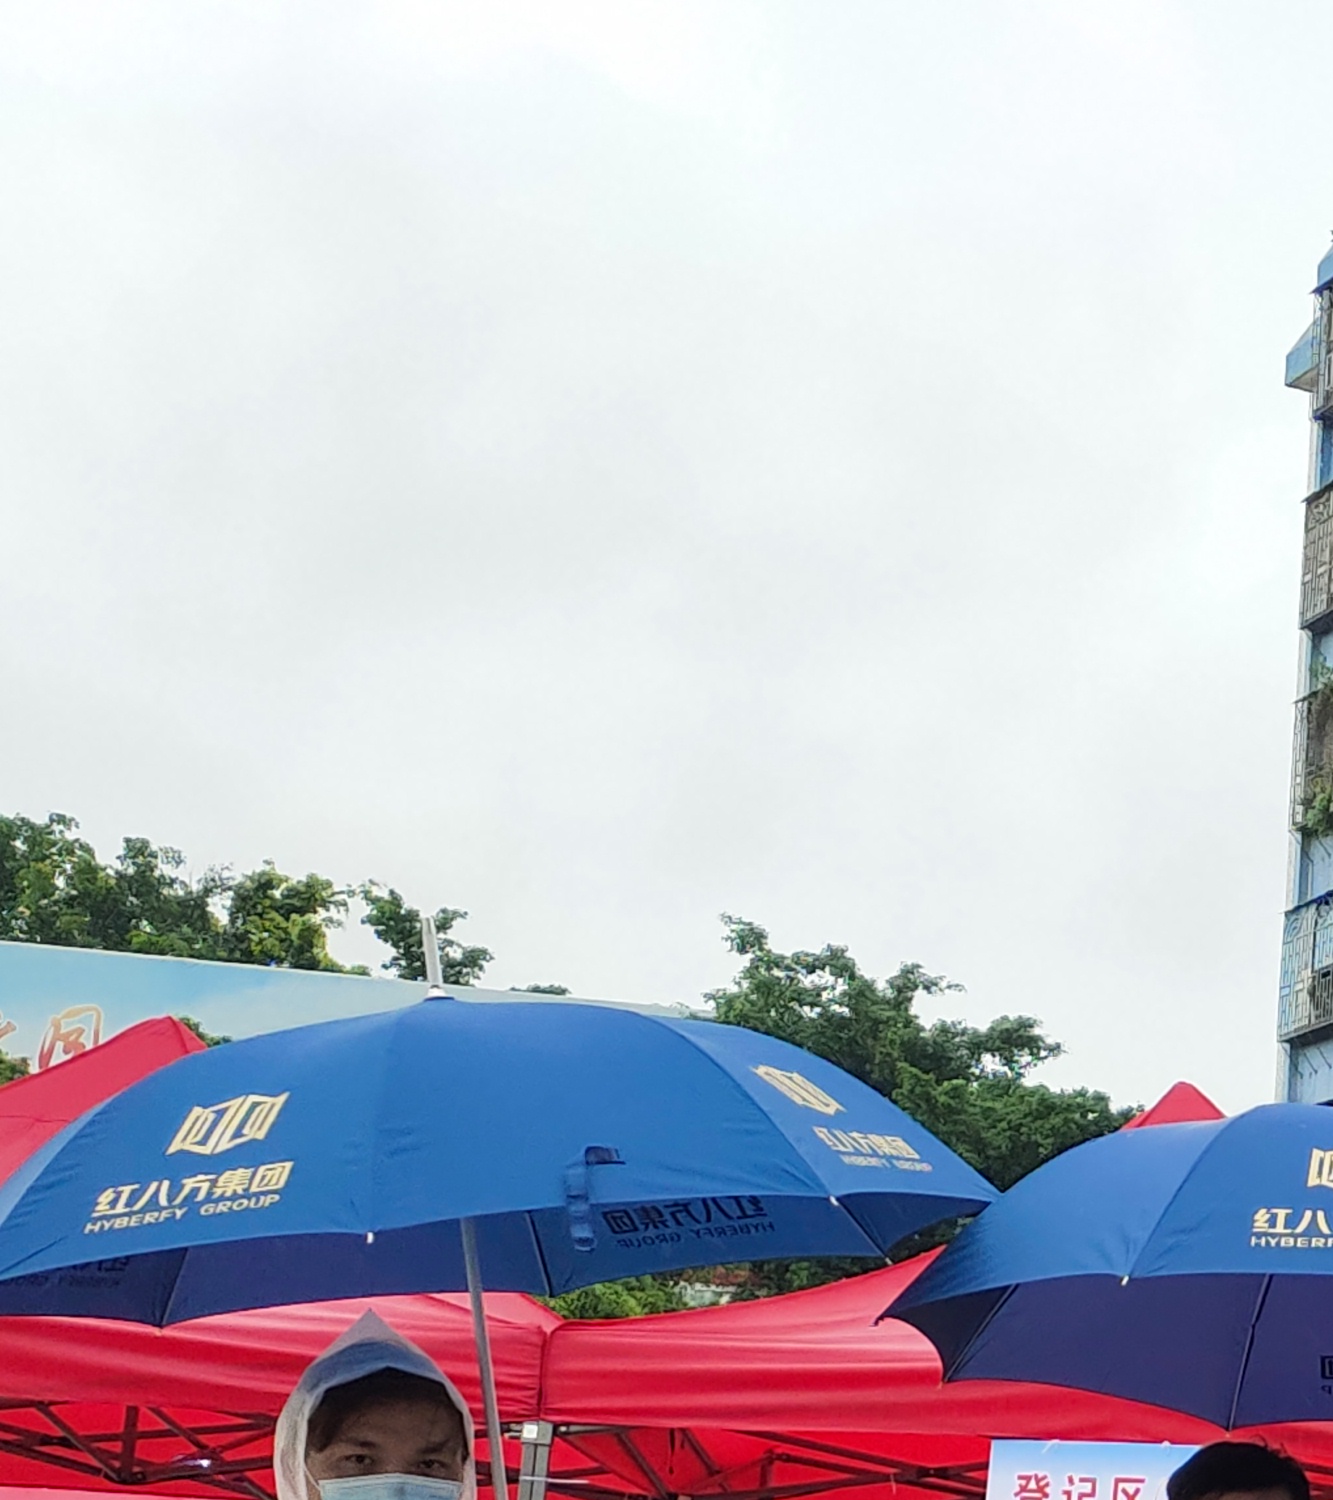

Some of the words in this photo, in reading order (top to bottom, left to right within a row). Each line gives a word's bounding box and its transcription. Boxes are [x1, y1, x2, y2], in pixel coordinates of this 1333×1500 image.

[82, 1206, 189, 1235] HYBERFY
[199, 1193, 281, 1217] GROUP
[90, 1160, 295, 1219] 红八方集团
